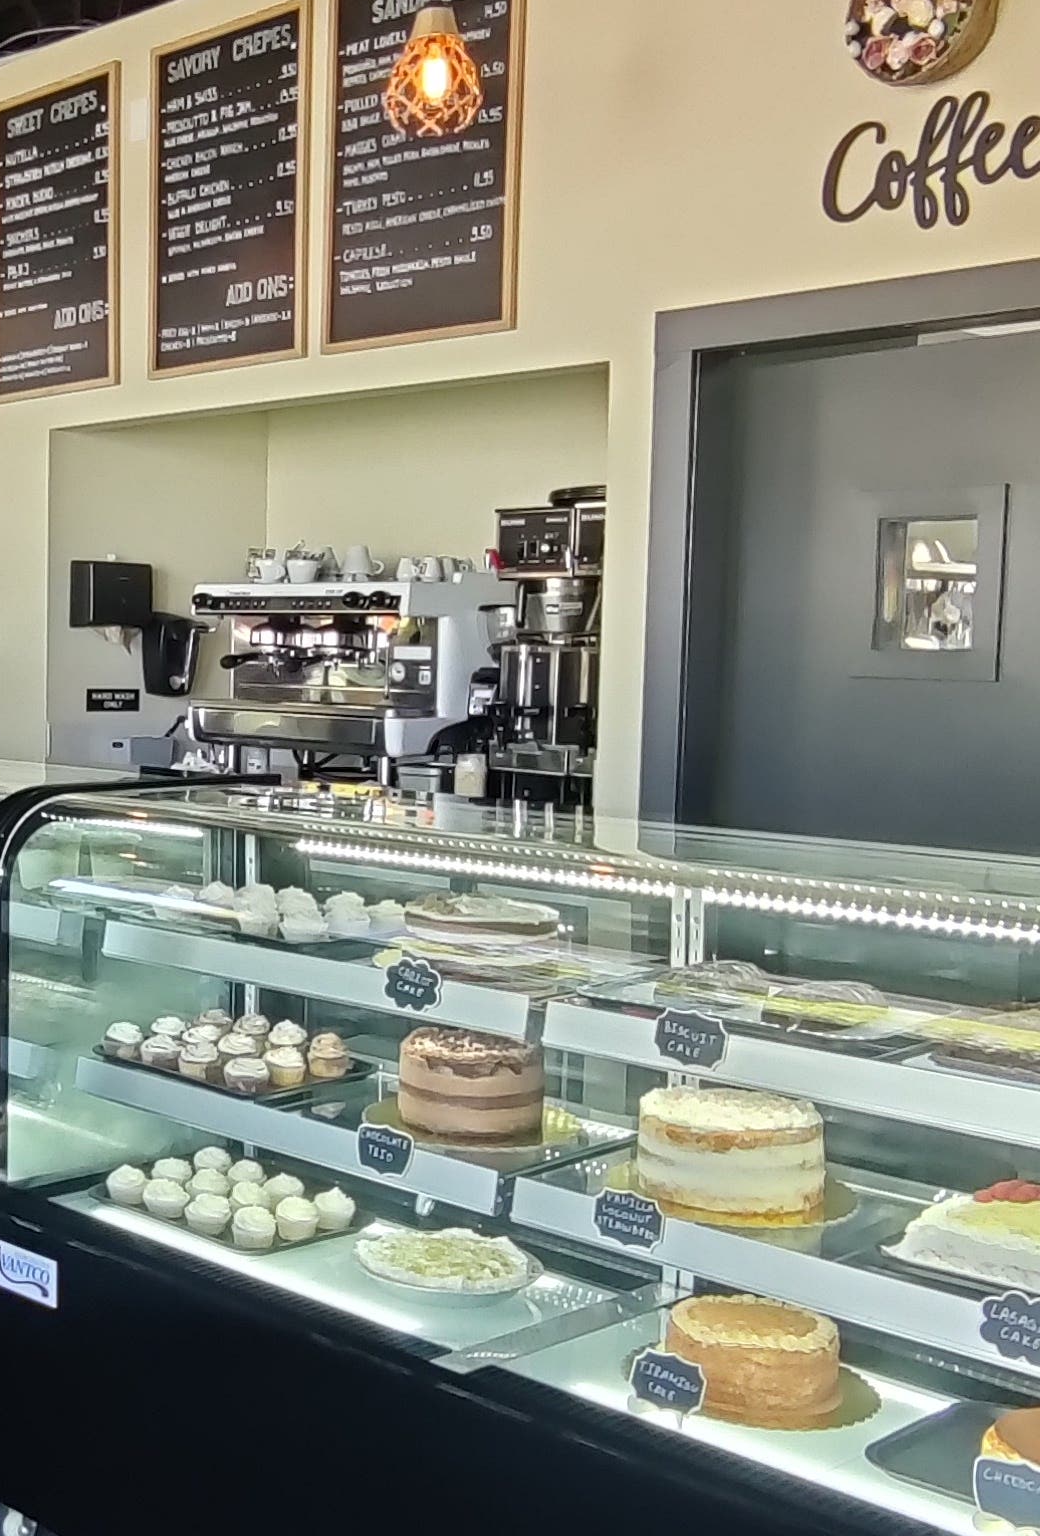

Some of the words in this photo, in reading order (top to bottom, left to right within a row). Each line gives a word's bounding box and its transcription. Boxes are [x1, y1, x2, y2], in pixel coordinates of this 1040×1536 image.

[167, 46, 221, 84] SAVORY
[7, 108, 45, 139] SWEET
[822, 91, 1040, 230] Coffee
[225, 281, 253, 307] ADD
[53, 306, 77, 330] ADD
[666, 1040, 701, 1058] CAKE
[606, 1192, 655, 1213] VANILLA
[639, 1360, 700, 1393] TIRAMISU
[647, 1381, 677, 1401] CAKE
